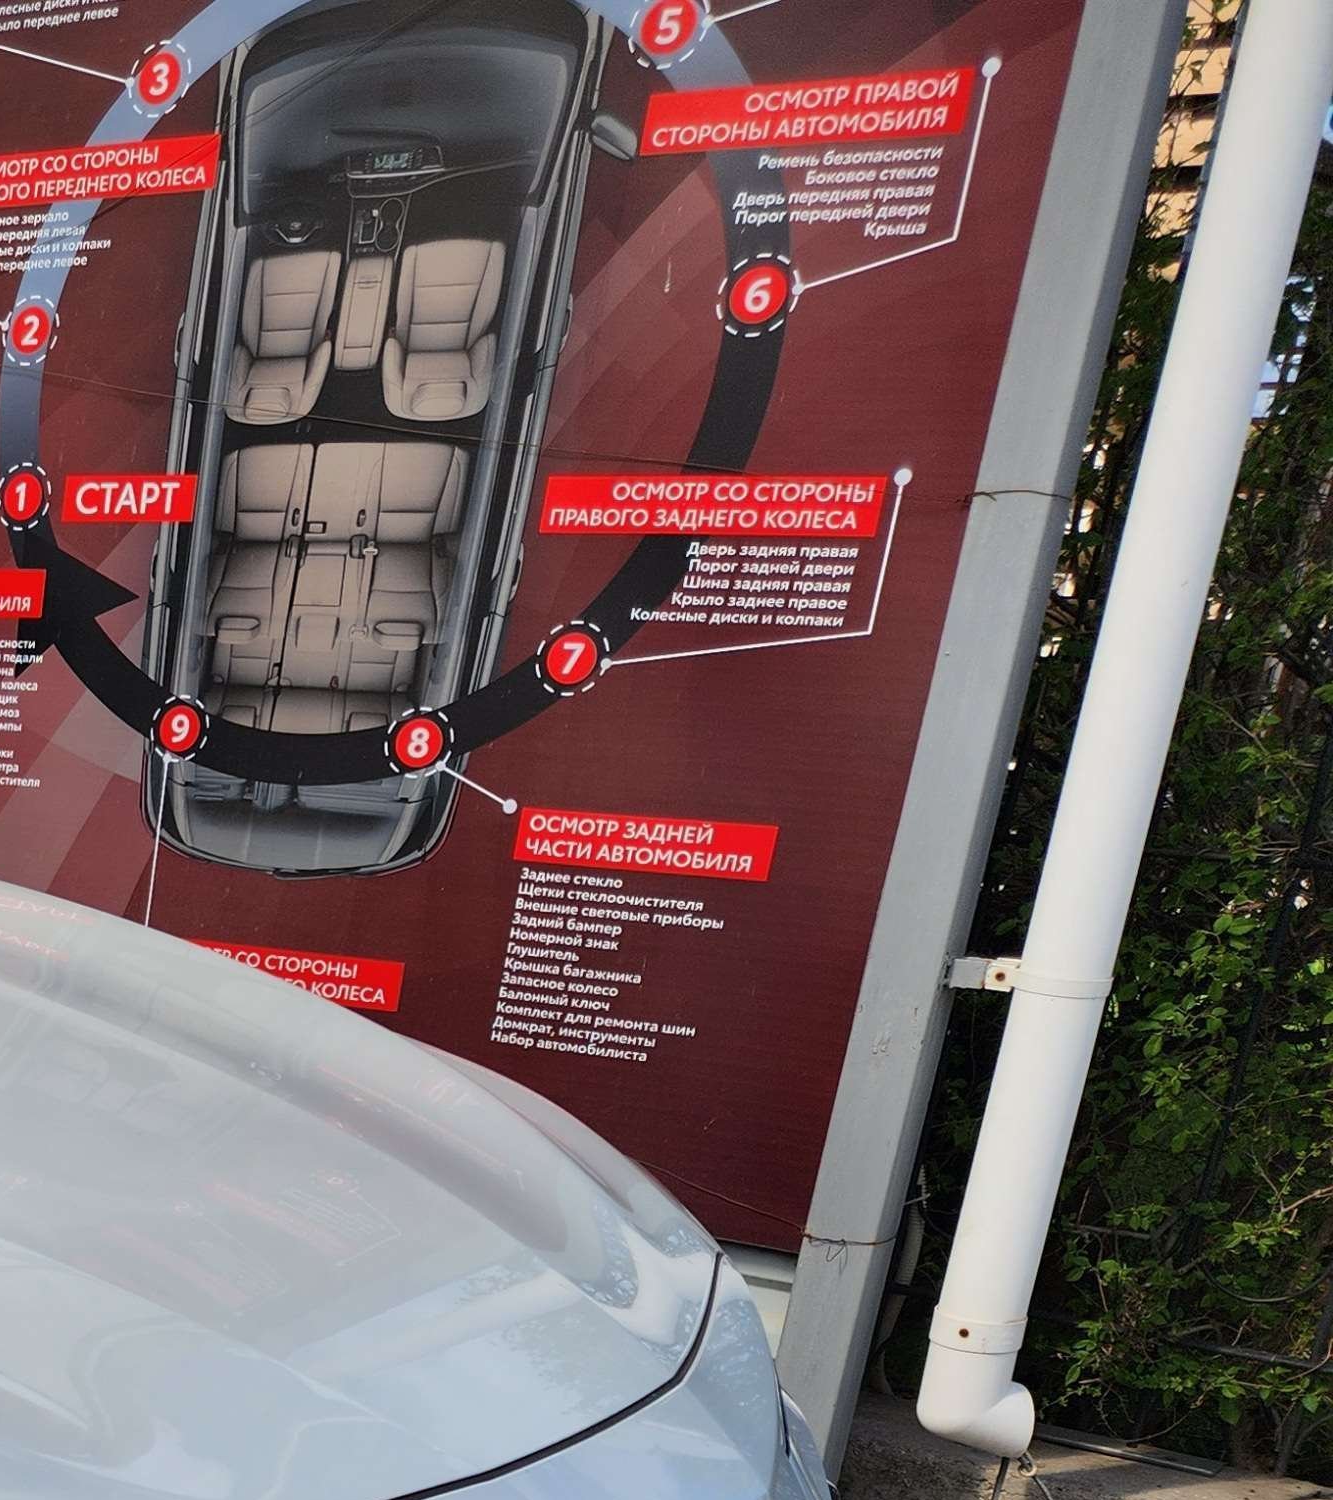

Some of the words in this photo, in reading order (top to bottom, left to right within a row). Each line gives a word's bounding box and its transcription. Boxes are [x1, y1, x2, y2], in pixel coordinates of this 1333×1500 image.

[23, 12, 80, 32] переднее
[83, 6, 119, 22] левое
[655, 6, 682, 46] 5
[148, 62, 170, 97] 3
[745, 87, 849, 113] ОСМОТР
[854, 72, 960, 105] ПРАВОЙ
[652, 121, 769, 148] СТОРОНЫ
[774, 105, 949, 139] АВТОМОБИЛЯ
[42, 154, 67, 174] СО
[71, 146, 159, 171] СТОРОНЫ
[758, 155, 820, 170] Ремень
[823, 145, 945, 165] безопасности
[33, 173, 132, 198] ПЕРЕДНЕГО
[135, 167, 206, 188] КОЛЕСА
[805, 170, 876, 185] Боковое
[879, 165, 939, 180] стекло
[733, 192, 785, 210] Дверь
[788, 190, 870, 207] передняя
[872, 184, 935, 201] правая
[21, 211, 69, 227] зеркало
[734, 209, 786, 227] Порог
[789, 203, 873, 225] передней
[875, 202, 932, 220] двери
[863, 222, 927, 240] Крыша
[15, 245, 49, 257] диски
[52, 242, 60, 250] и
[62, 239, 111, 251] колпаки
[53, 256, 88, 268] левое
[744, 282, 771, 314] 6
[19, 314, 40, 347] 2
[15, 481, 27, 512] 1
[75, 481, 181, 515] СТАРТ
[612, 481, 709, 503] ОСМОТР
[713, 482, 749, 503] СО
[755, 483, 876, 504] СТОРОНЫ
[548, 508, 649, 527] ПРАВОГО
[652, 509, 758, 532] ЗАДНЕГО
[763, 509, 858, 530] КОЛЕСА
[685, 541, 737, 558] Дверь
[739, 544, 797, 559] задняя
[799, 546, 859, 560] правая
[689, 559, 738, 574] Порог
[741, 560, 800, 576] задней
[801, 564, 855, 577] двери
[683, 576, 729, 589] Шина
[732, 578, 790, 591] задняя
[792, 580, 852, 594] правая
[671, 592, 725, 608] Крыло
[727, 595, 785, 609] заднее
[788, 597, 848, 611] правое
[630, 608, 707, 623] Колесные
[709, 611, 759, 626] диски
[761, 614, 773, 624] и
[775, 615, 844, 628] колпаки
[3, 654, 43, 664] педали
[560, 642, 586, 675] 7
[1, 681, 38, 691] колеса
[171, 714, 189, 743] 9
[407, 726, 430, 759] 8
[529, 815, 620, 838] ОСМОТР
[622, 823, 715, 845] ЗАДНЕЙ
[525, 837, 592, 859] ЧАСТИ
[596, 844, 753, 873] АВТОМОБИЛЯ
[520, 868, 571, 884] Заднее
[573, 874, 623, 888] стекло
[517, 882, 565, 899] Щетки
[567, 890, 704, 912] стеклоочистителя
[512, 912, 564, 931] Задний
[567, 919, 623, 938] бампер
[514, 898, 579, 916] Внешние
[581, 906, 650, 922] световые
[652, 913, 725, 932] приборы
[506, 942, 580, 962] Глушитель
[509, 927, 583, 947] Номерной
[585, 939, 620, 951] знак
[235, 951, 261, 968] СО
[264, 954, 358, 979] СТОРОНЫ
[504, 957, 560, 976] Крышка
[562, 964, 642, 985] багажника
[311, 981, 386, 1004] КОЛЕСА
[501, 972, 566, 991] Запасное
[567, 982, 619, 997] колесо
[498, 986, 569, 1006] Балонный
[571, 999, 611, 1012] ключ
[492, 1015, 556, 1037] Домкрат,
[558, 1026, 656, 1048] инструменты
[496, 1001, 563, 1021] Комплект
[564, 1013, 592, 1026] для
[594, 1016, 659, 1034] ремонта
[661, 1026, 696, 1037] шин
[490, 1031, 534, 1049] Набор
[537, 1038, 648, 1062] автомобилиста
